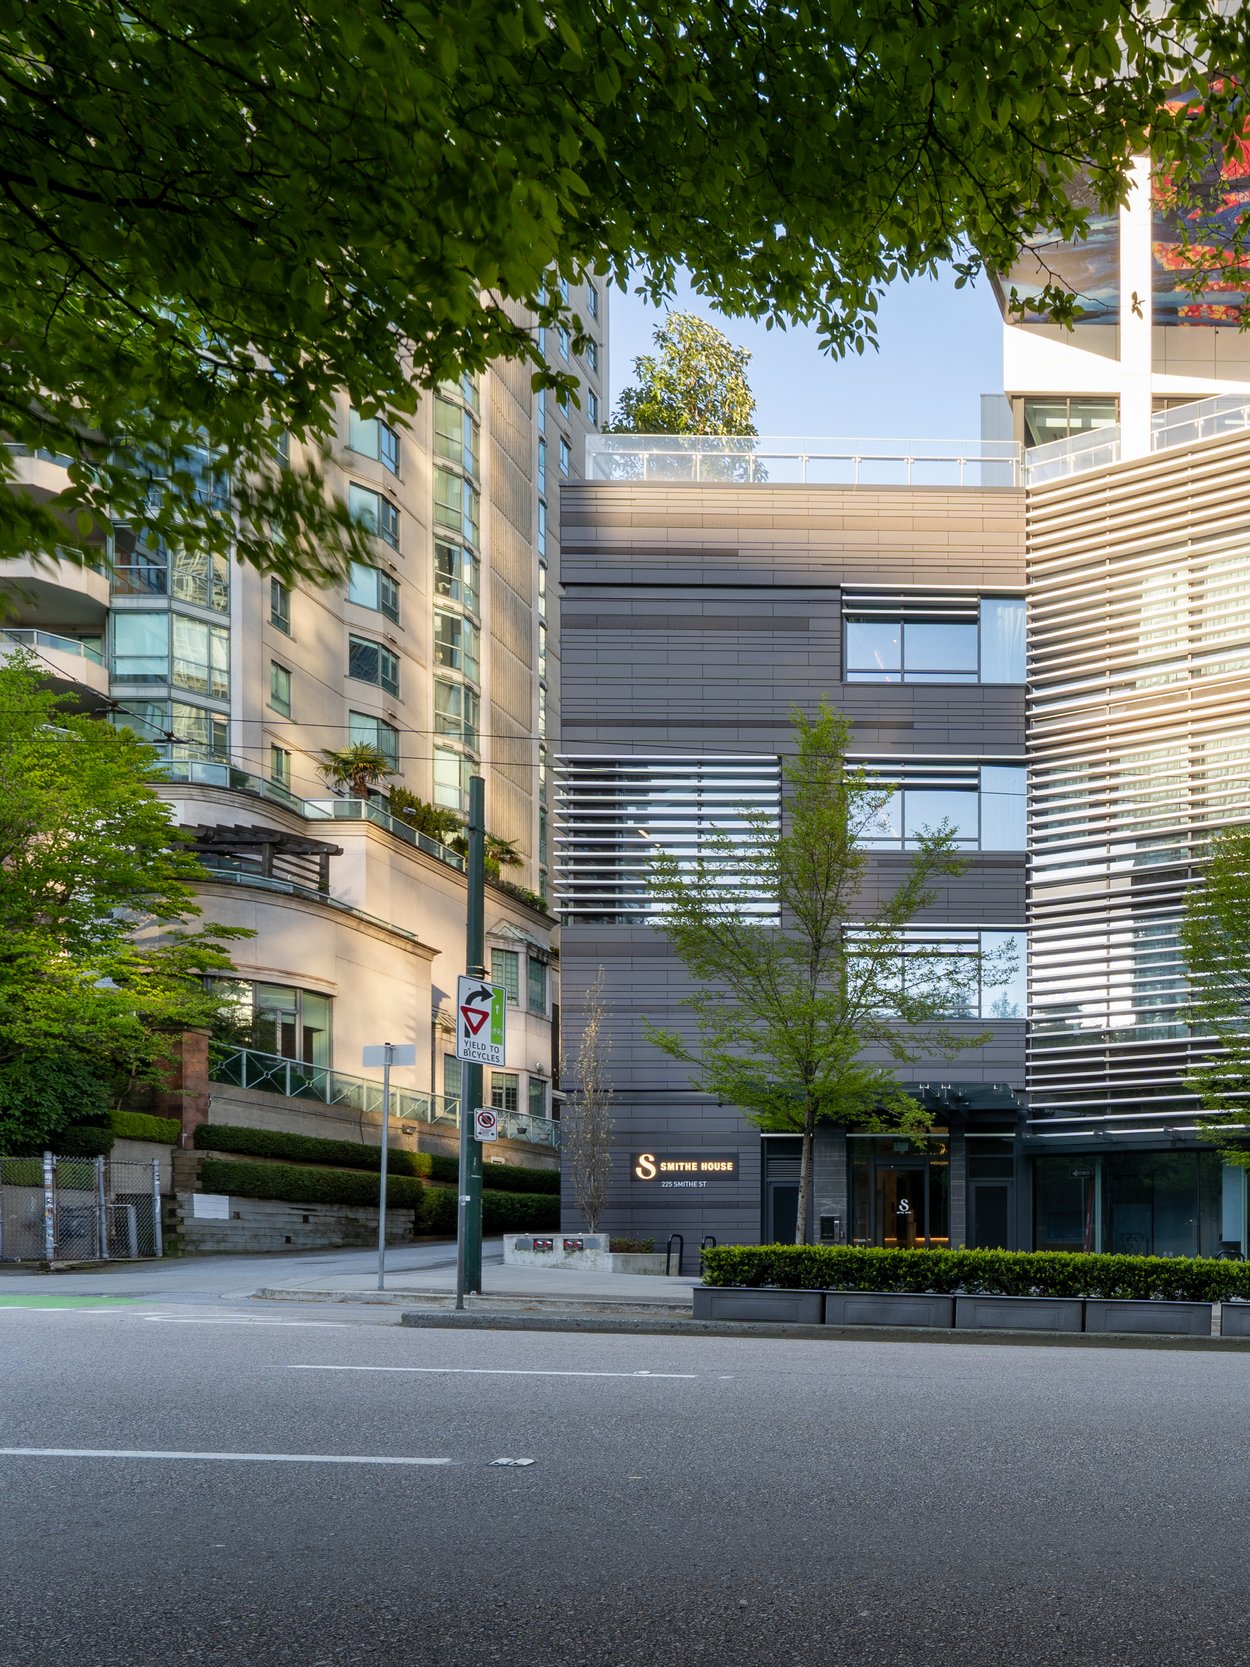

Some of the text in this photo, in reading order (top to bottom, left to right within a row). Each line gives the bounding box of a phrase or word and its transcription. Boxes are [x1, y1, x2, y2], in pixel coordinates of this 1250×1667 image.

[464, 1040, 500, 1054] YIELD TO
[463, 1049, 500, 1062] BICYCLES
[635, 1154, 656, 1179] S
[660, 1162, 733, 1171] SMITHE HOUSE
[899, 1199, 909, 1211] S
